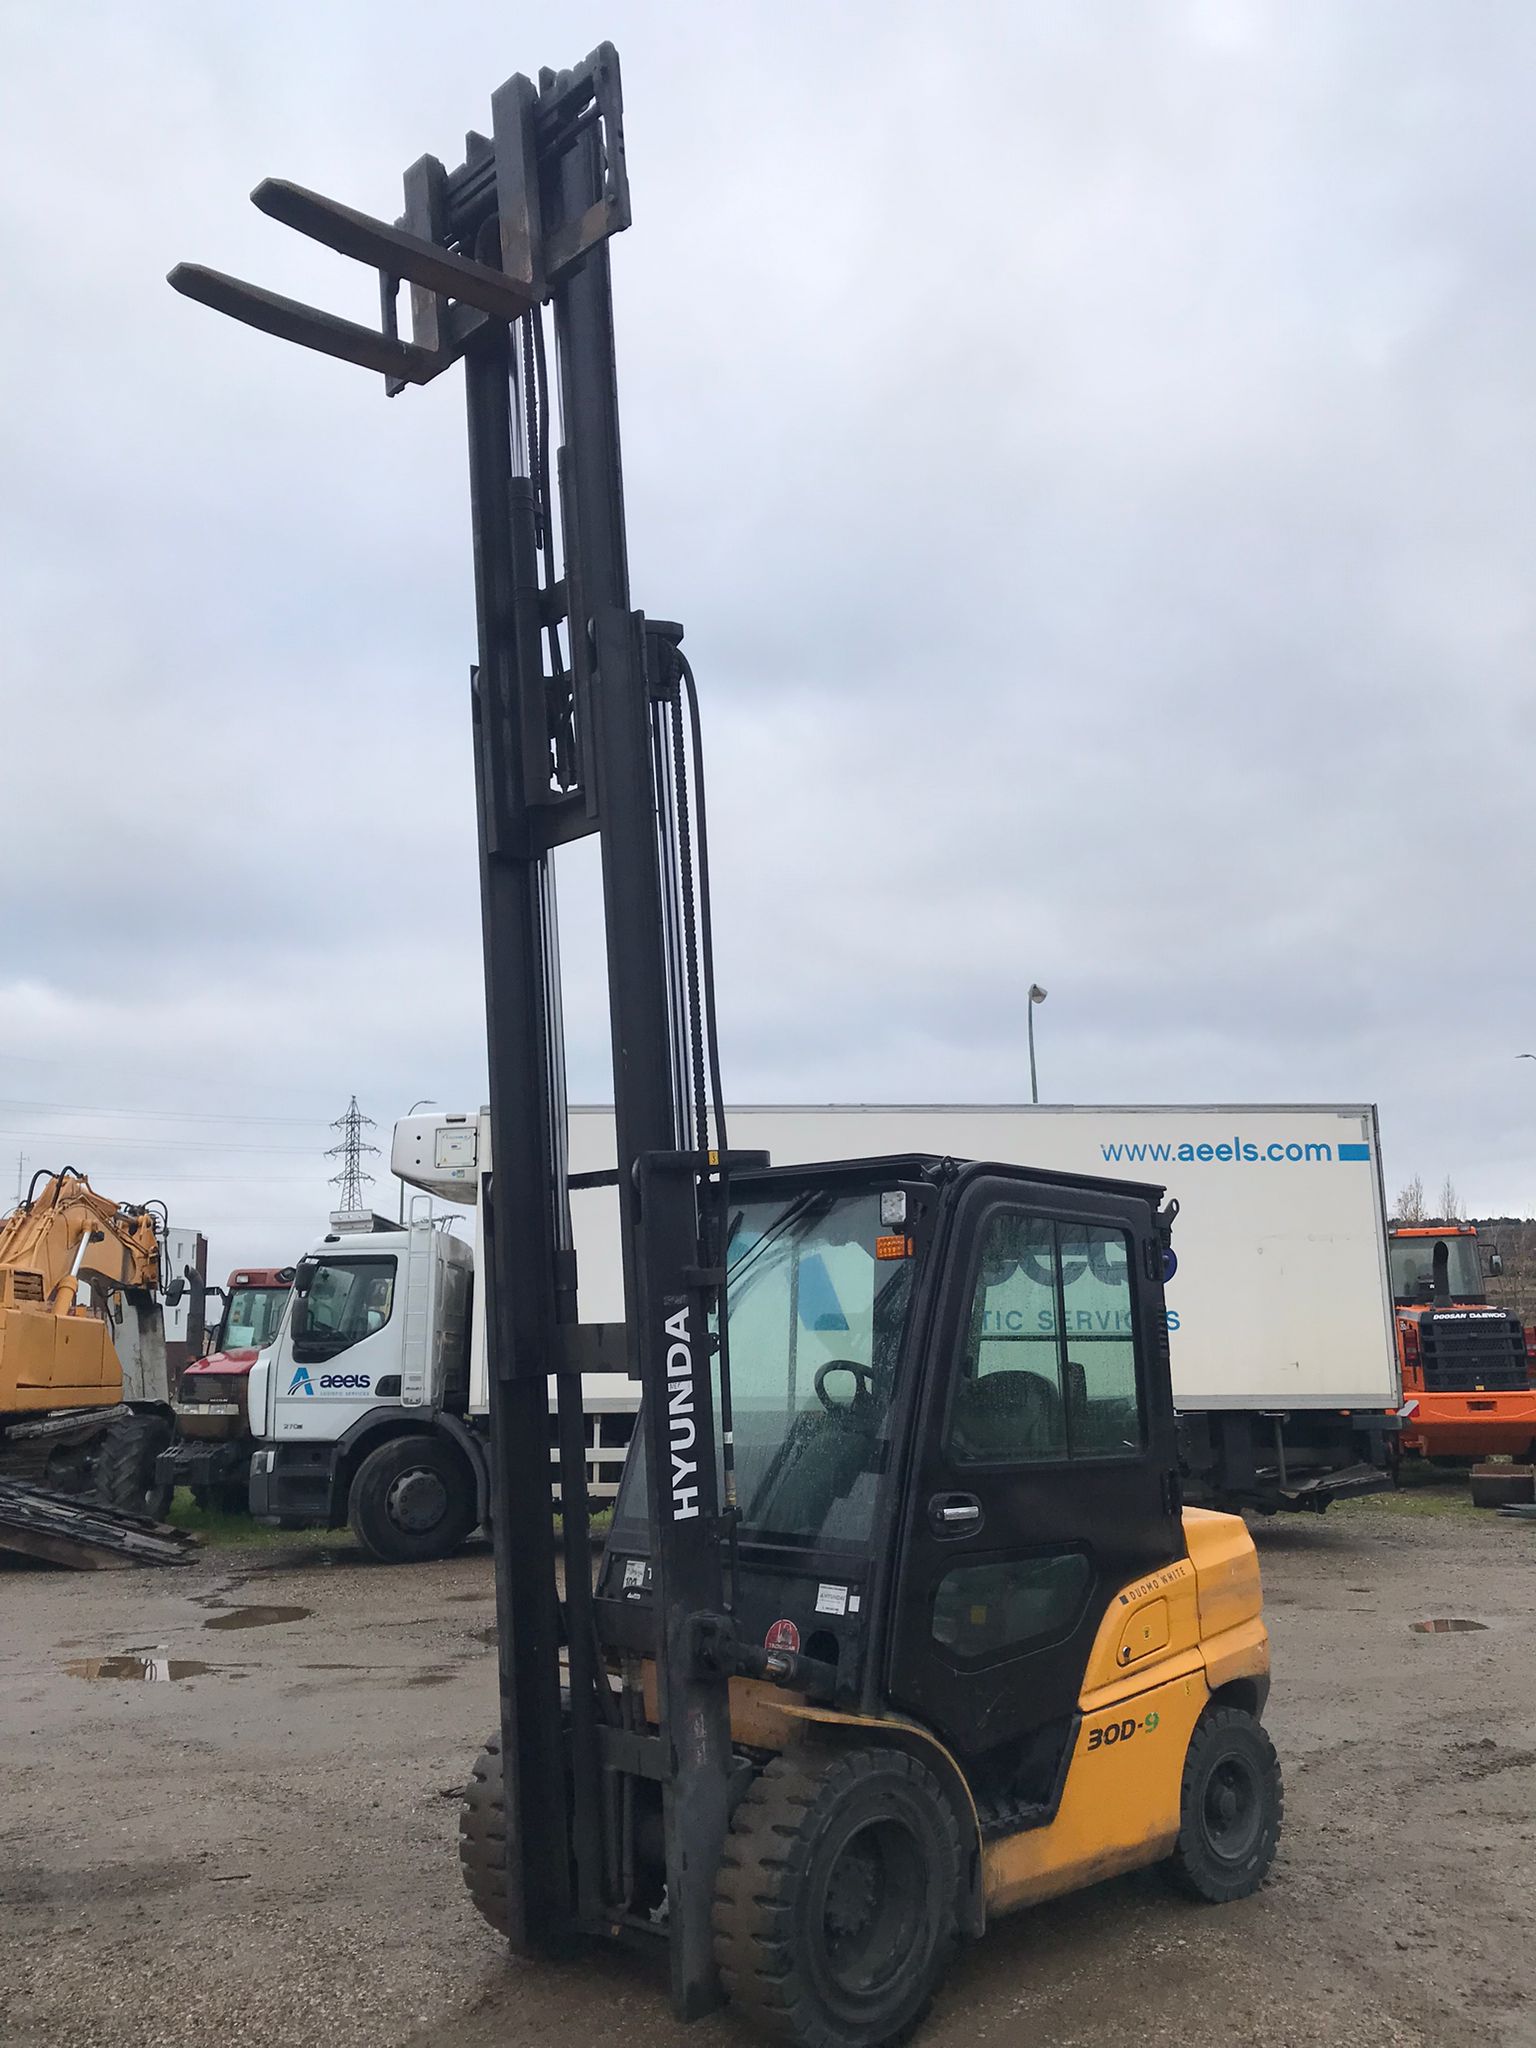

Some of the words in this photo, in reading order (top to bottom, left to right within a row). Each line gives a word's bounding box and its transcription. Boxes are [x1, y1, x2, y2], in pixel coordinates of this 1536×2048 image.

[1100, 1136, 1332, 1162] www.aeels.com
[1129, 1579, 1159, 1600] DUOMO
[1160, 1566, 1186, 1584] WHITE
[1087, 1711, 1160, 1751] 30D-9
